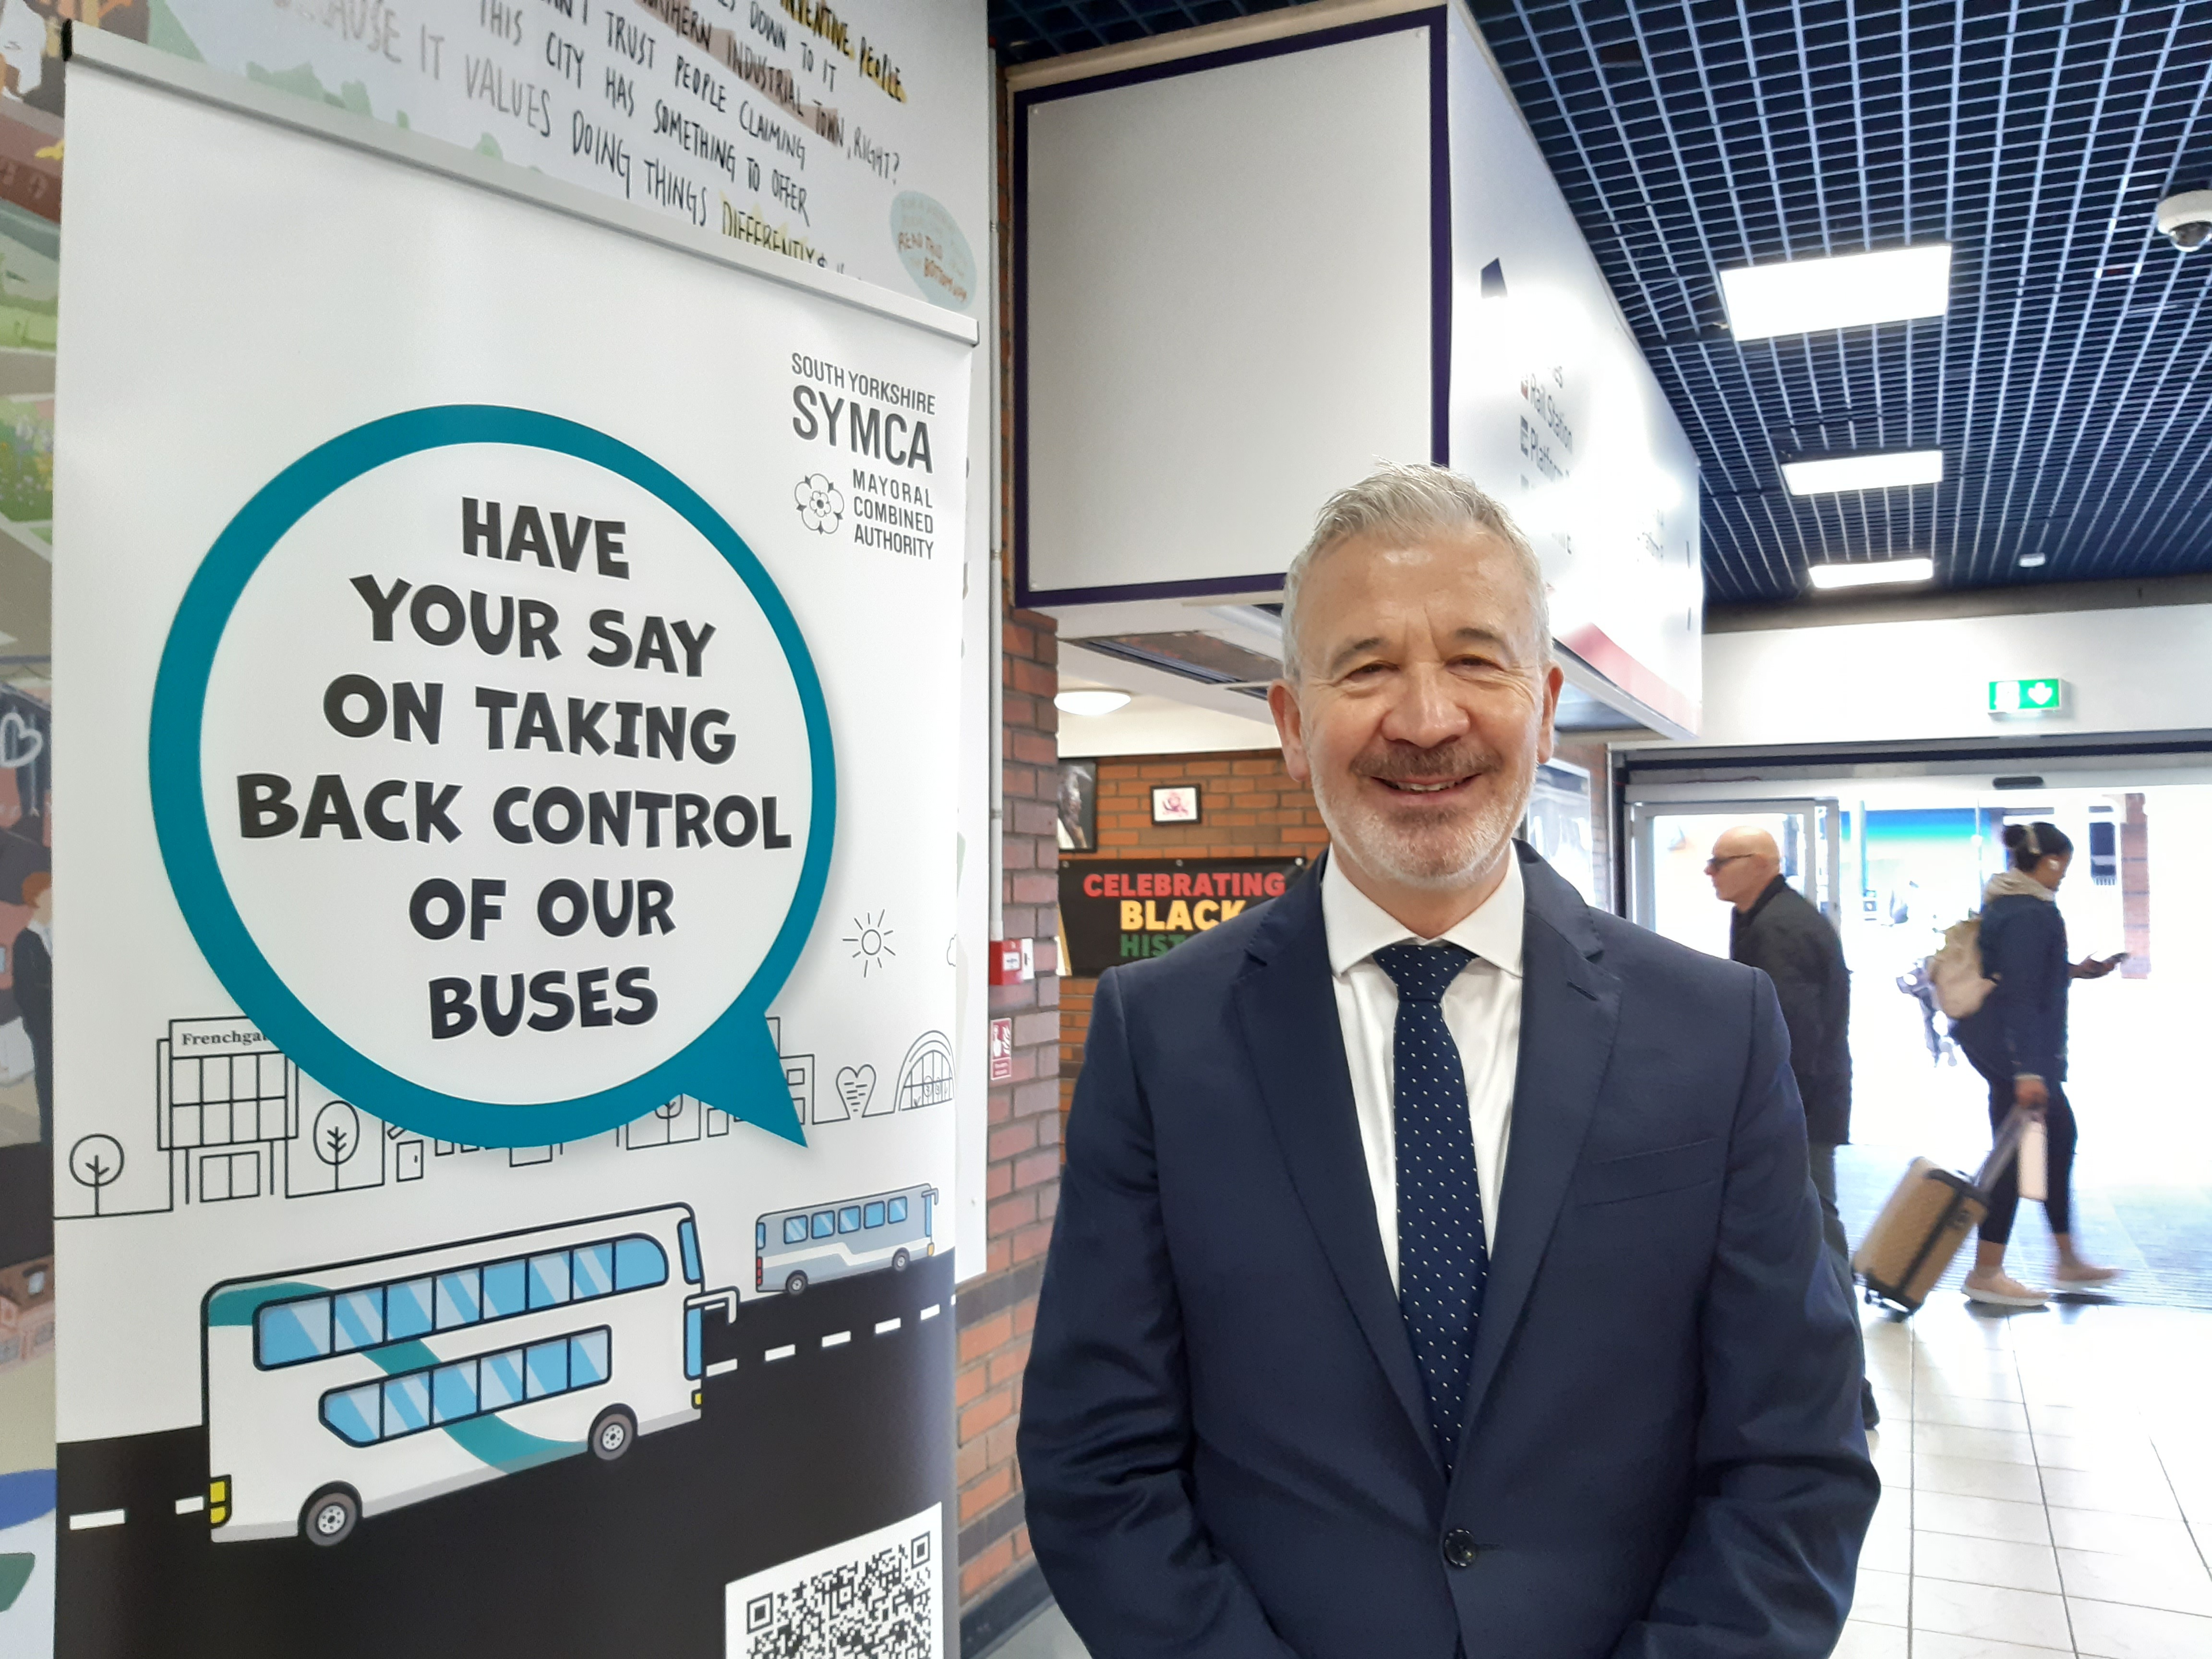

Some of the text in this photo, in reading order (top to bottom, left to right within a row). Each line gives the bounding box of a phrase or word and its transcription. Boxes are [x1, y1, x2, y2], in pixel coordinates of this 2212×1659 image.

[605, 11, 655, 69] TRUST
[675, 54, 726, 113] PEOPLE
[739, 100, 806, 170] CLAIMING
[727, 35, 804, 117] INDUSTRIAL
[800, 41, 814, 72] TO
[823, 58, 836, 92] IT
[421, 24, 445, 80] IT
[466, 53, 551, 138] VALUES
[573, 109, 630, 200] DOING
[644, 157, 707, 227] THINGS
[546, 31, 584, 89] CITY
[606, 67, 634, 117] HAS
[653, 99, 736, 183] SOMETHING
[747, 156, 760, 192] TO
[771, 169, 810, 227] OFFER
[792, 352, 936, 415] SOUTH YORKSHIRE
[793, 385, 933, 474] SYMCA
[853, 469, 933, 508] MAYORAL
[854, 496, 933, 534] COMBINED
[463, 497, 629, 579] HAVE
[854, 524, 934, 560] AUTHORITY
[349, 575, 715, 676] YOUR SAY
[324, 674, 735, 764] ON TAKING
[237, 774, 791, 849] BACK CONTROL
[409, 878, 675, 940] OF OUR
[1083, 872, 1286, 897] CELEBRATING
[1120, 934, 1187, 957] HIST
[429, 967, 657, 1039] BUSES
